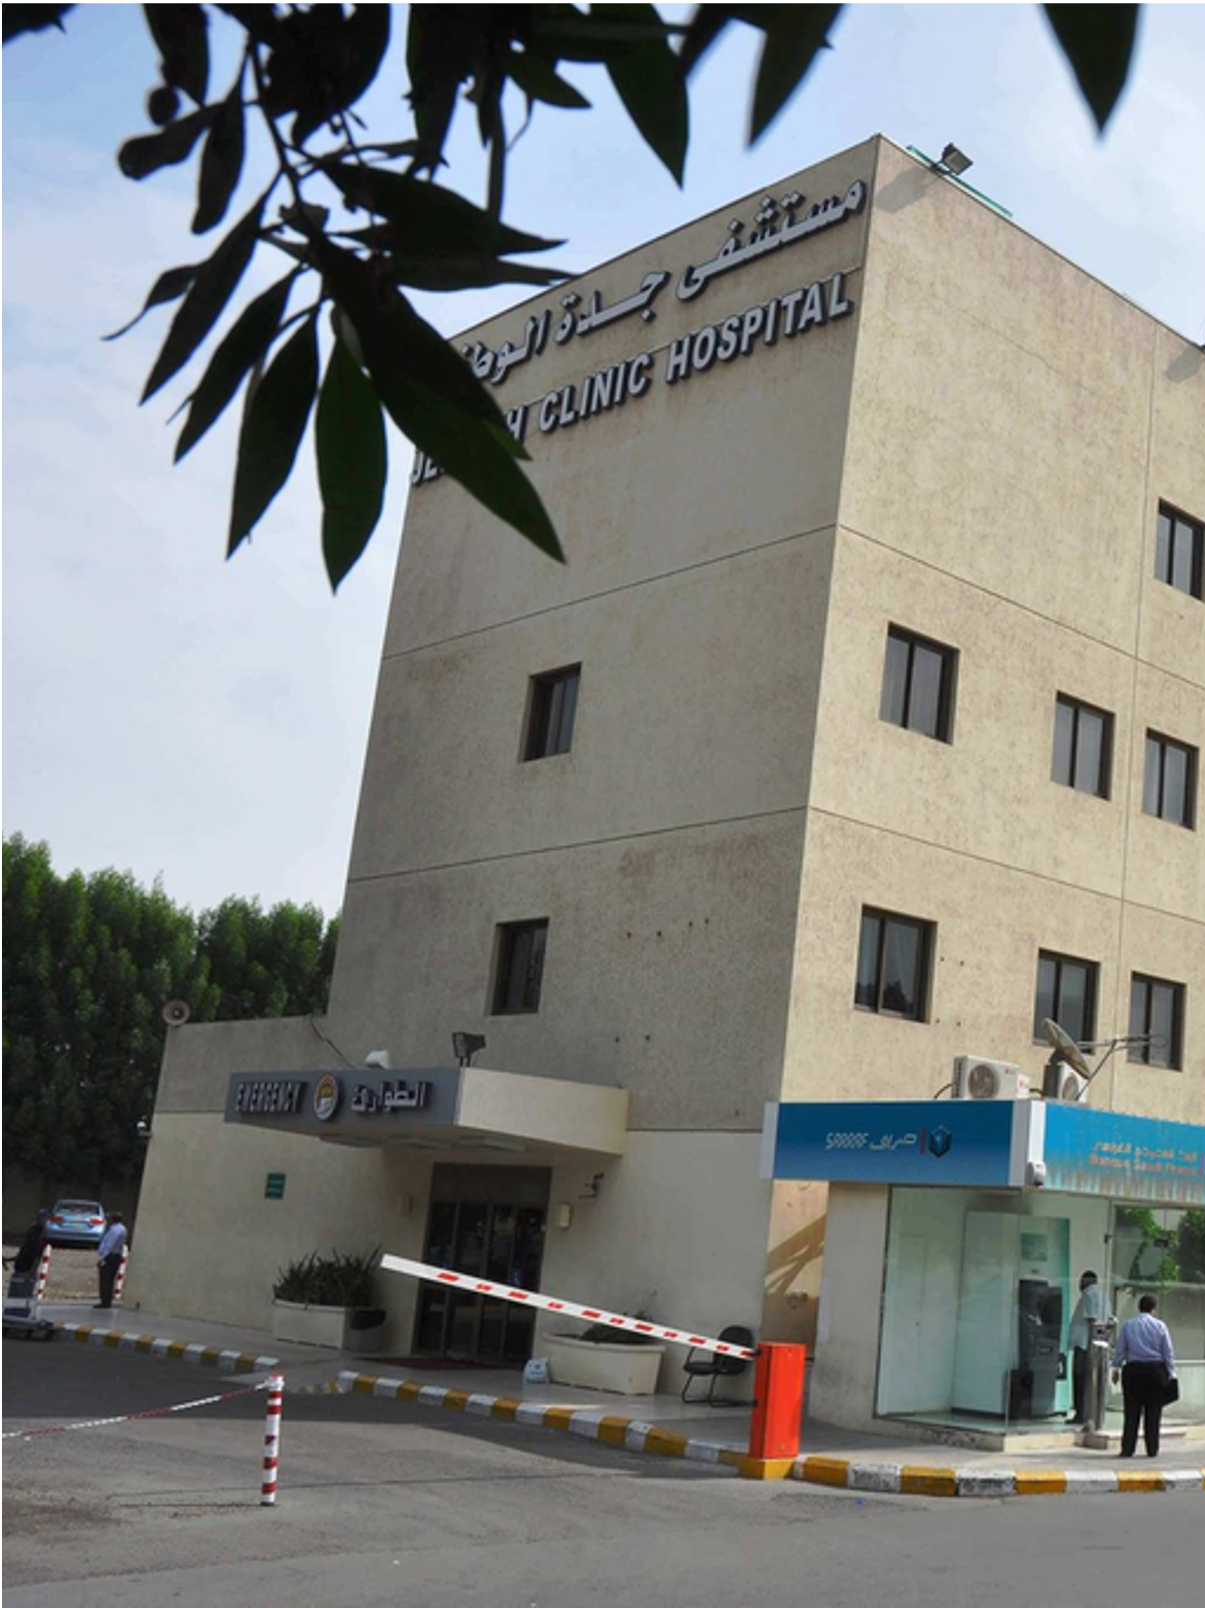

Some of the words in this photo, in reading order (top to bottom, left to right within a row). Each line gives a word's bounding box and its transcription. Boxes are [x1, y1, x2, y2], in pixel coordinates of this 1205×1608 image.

[676, 179, 866, 300] مستشفى
[538, 352, 653, 435] CLINIC
[665, 272, 855, 386] HOSPITAL
[554, 268, 669, 345] جدة
